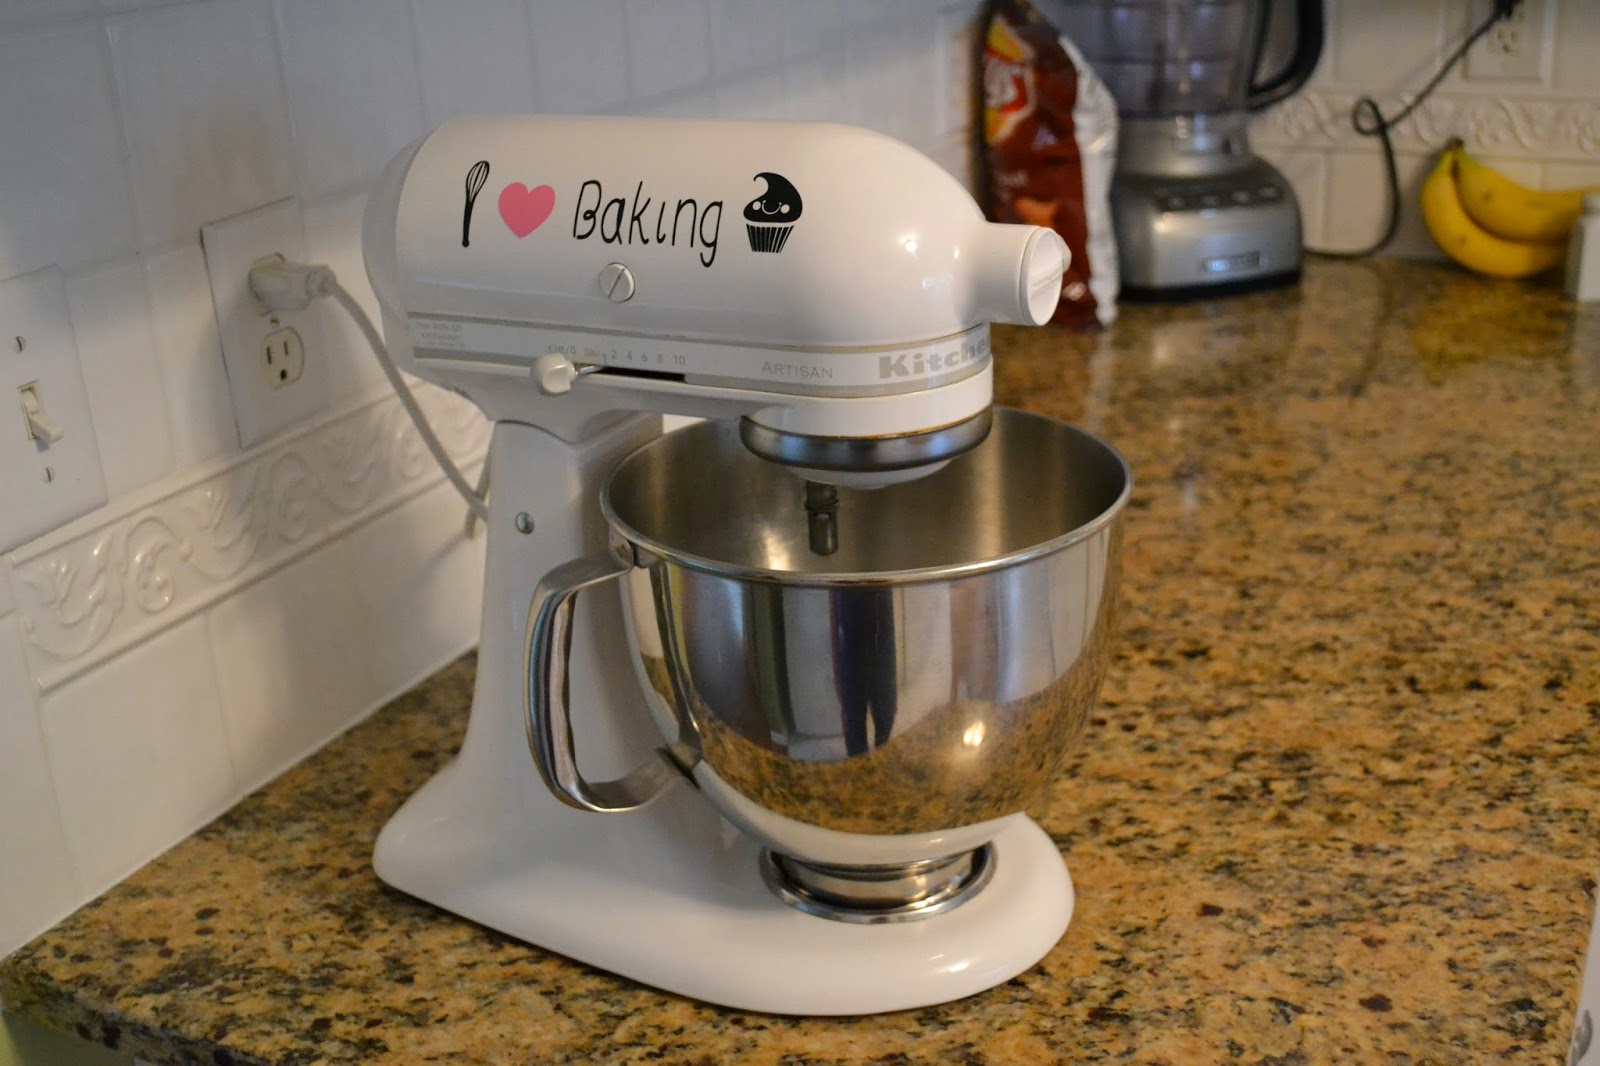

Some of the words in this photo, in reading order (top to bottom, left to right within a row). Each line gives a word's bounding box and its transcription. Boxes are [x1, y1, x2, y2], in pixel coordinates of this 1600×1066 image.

[573, 180, 723, 268] Baking
[610, 349, 618, 360] 2
[641, 352, 648, 363] 6
[656, 353, 664, 364] 8
[673, 355, 687, 366] 10
